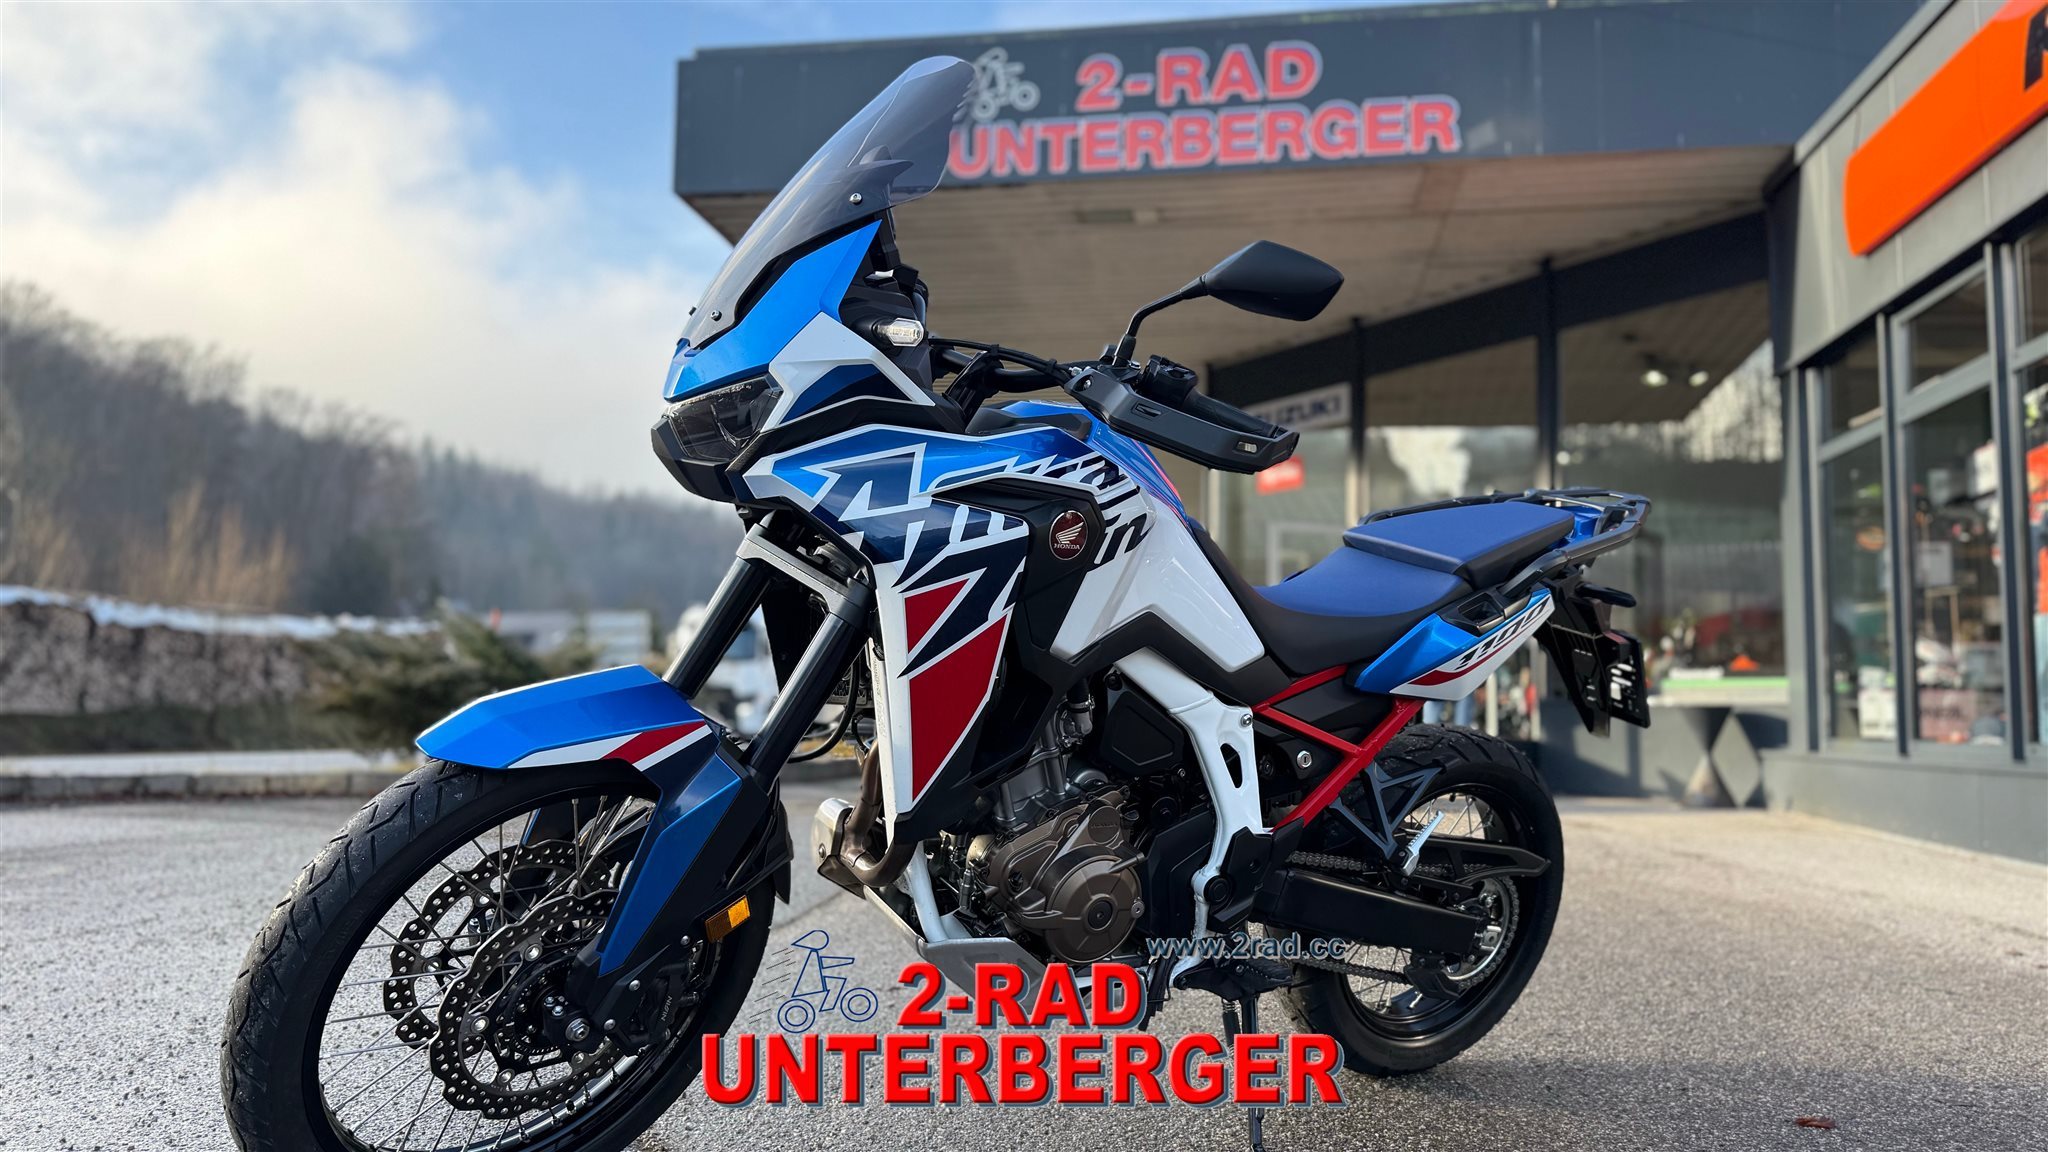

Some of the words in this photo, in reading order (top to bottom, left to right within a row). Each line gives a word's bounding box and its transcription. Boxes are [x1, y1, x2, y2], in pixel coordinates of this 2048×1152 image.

[1075, 41, 1322, 112] 2-RAD
[948, 93, 1461, 179] UNTERBERGER
[1454, 595, 1551, 671] 1100
